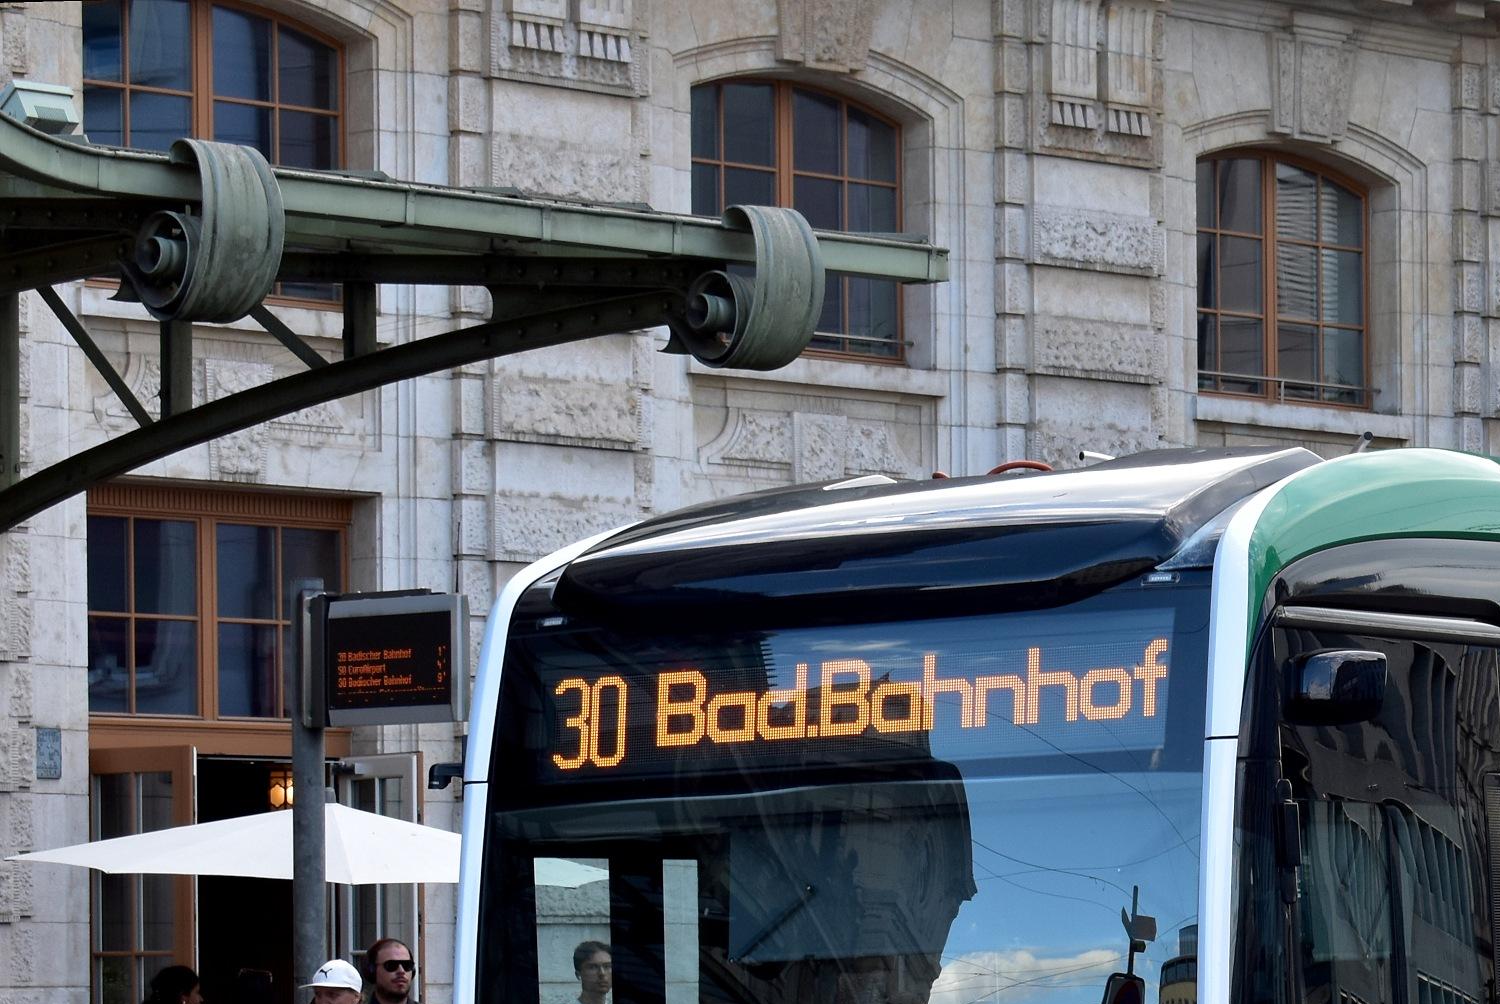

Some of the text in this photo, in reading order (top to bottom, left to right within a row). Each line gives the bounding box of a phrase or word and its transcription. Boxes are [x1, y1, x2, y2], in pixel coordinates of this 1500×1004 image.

[348, 650, 382, 662] Badischer
[384, 648, 412, 659] Bahnhof
[348, 676, 382, 688] Badischer
[384, 674, 412, 685] Bahnhof
[552, 638, 1168, 770] 30 Bad.Bahnhof
